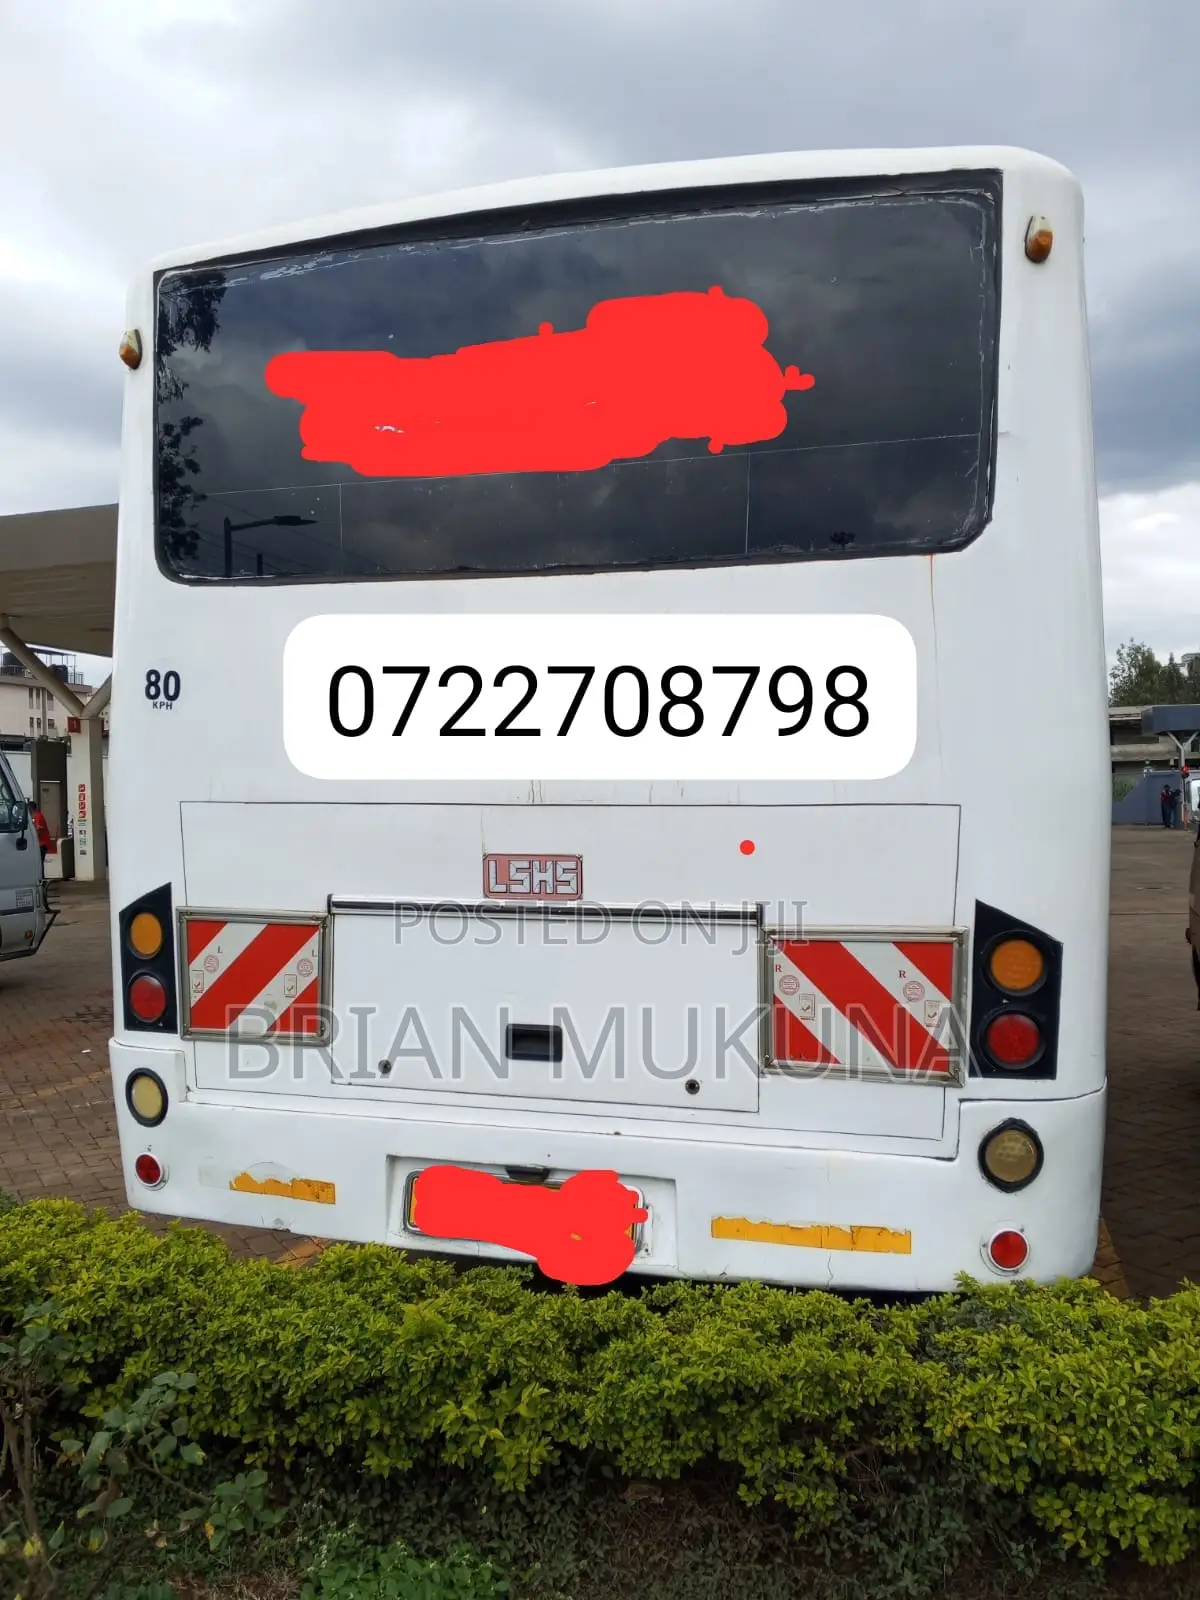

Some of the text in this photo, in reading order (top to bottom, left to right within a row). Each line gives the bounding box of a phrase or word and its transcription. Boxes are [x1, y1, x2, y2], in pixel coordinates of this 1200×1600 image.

[145, 669, 181, 702] 80
[152, 701, 173, 710] KPH
[217, 946, 223, 954] L
[311, 949, 317, 957] L
[775, 964, 782, 972] R
[899, 970, 906, 978] R
